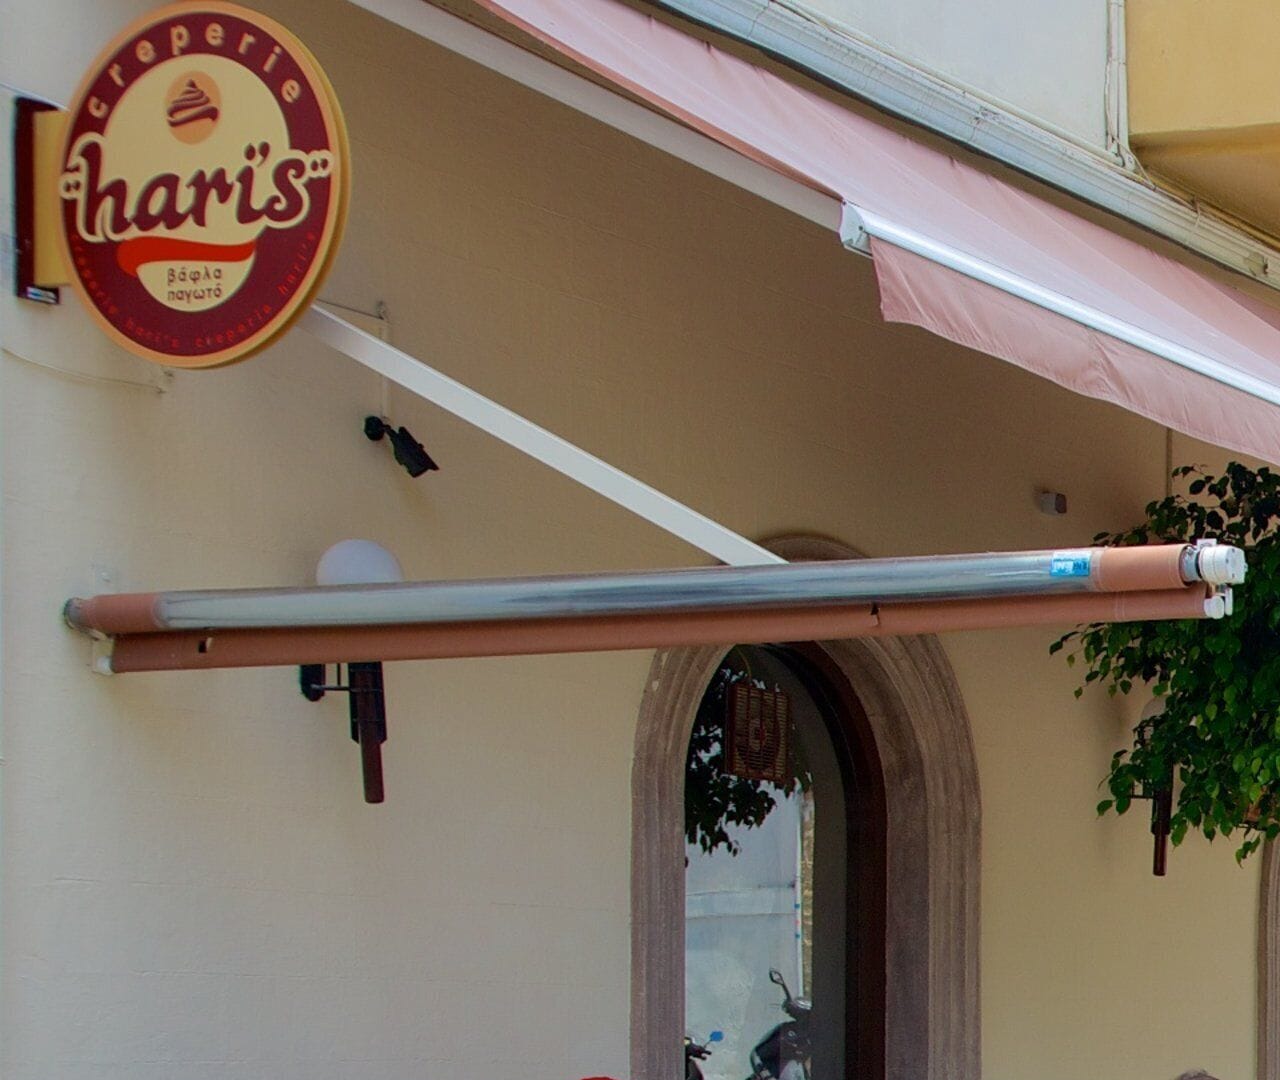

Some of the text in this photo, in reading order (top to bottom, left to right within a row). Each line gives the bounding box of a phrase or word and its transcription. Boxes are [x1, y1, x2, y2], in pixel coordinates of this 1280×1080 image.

[86, 21, 304, 119] creperie
[167, 265, 223, 286] βάφλα
[167, 283, 223, 304] παγωτό
